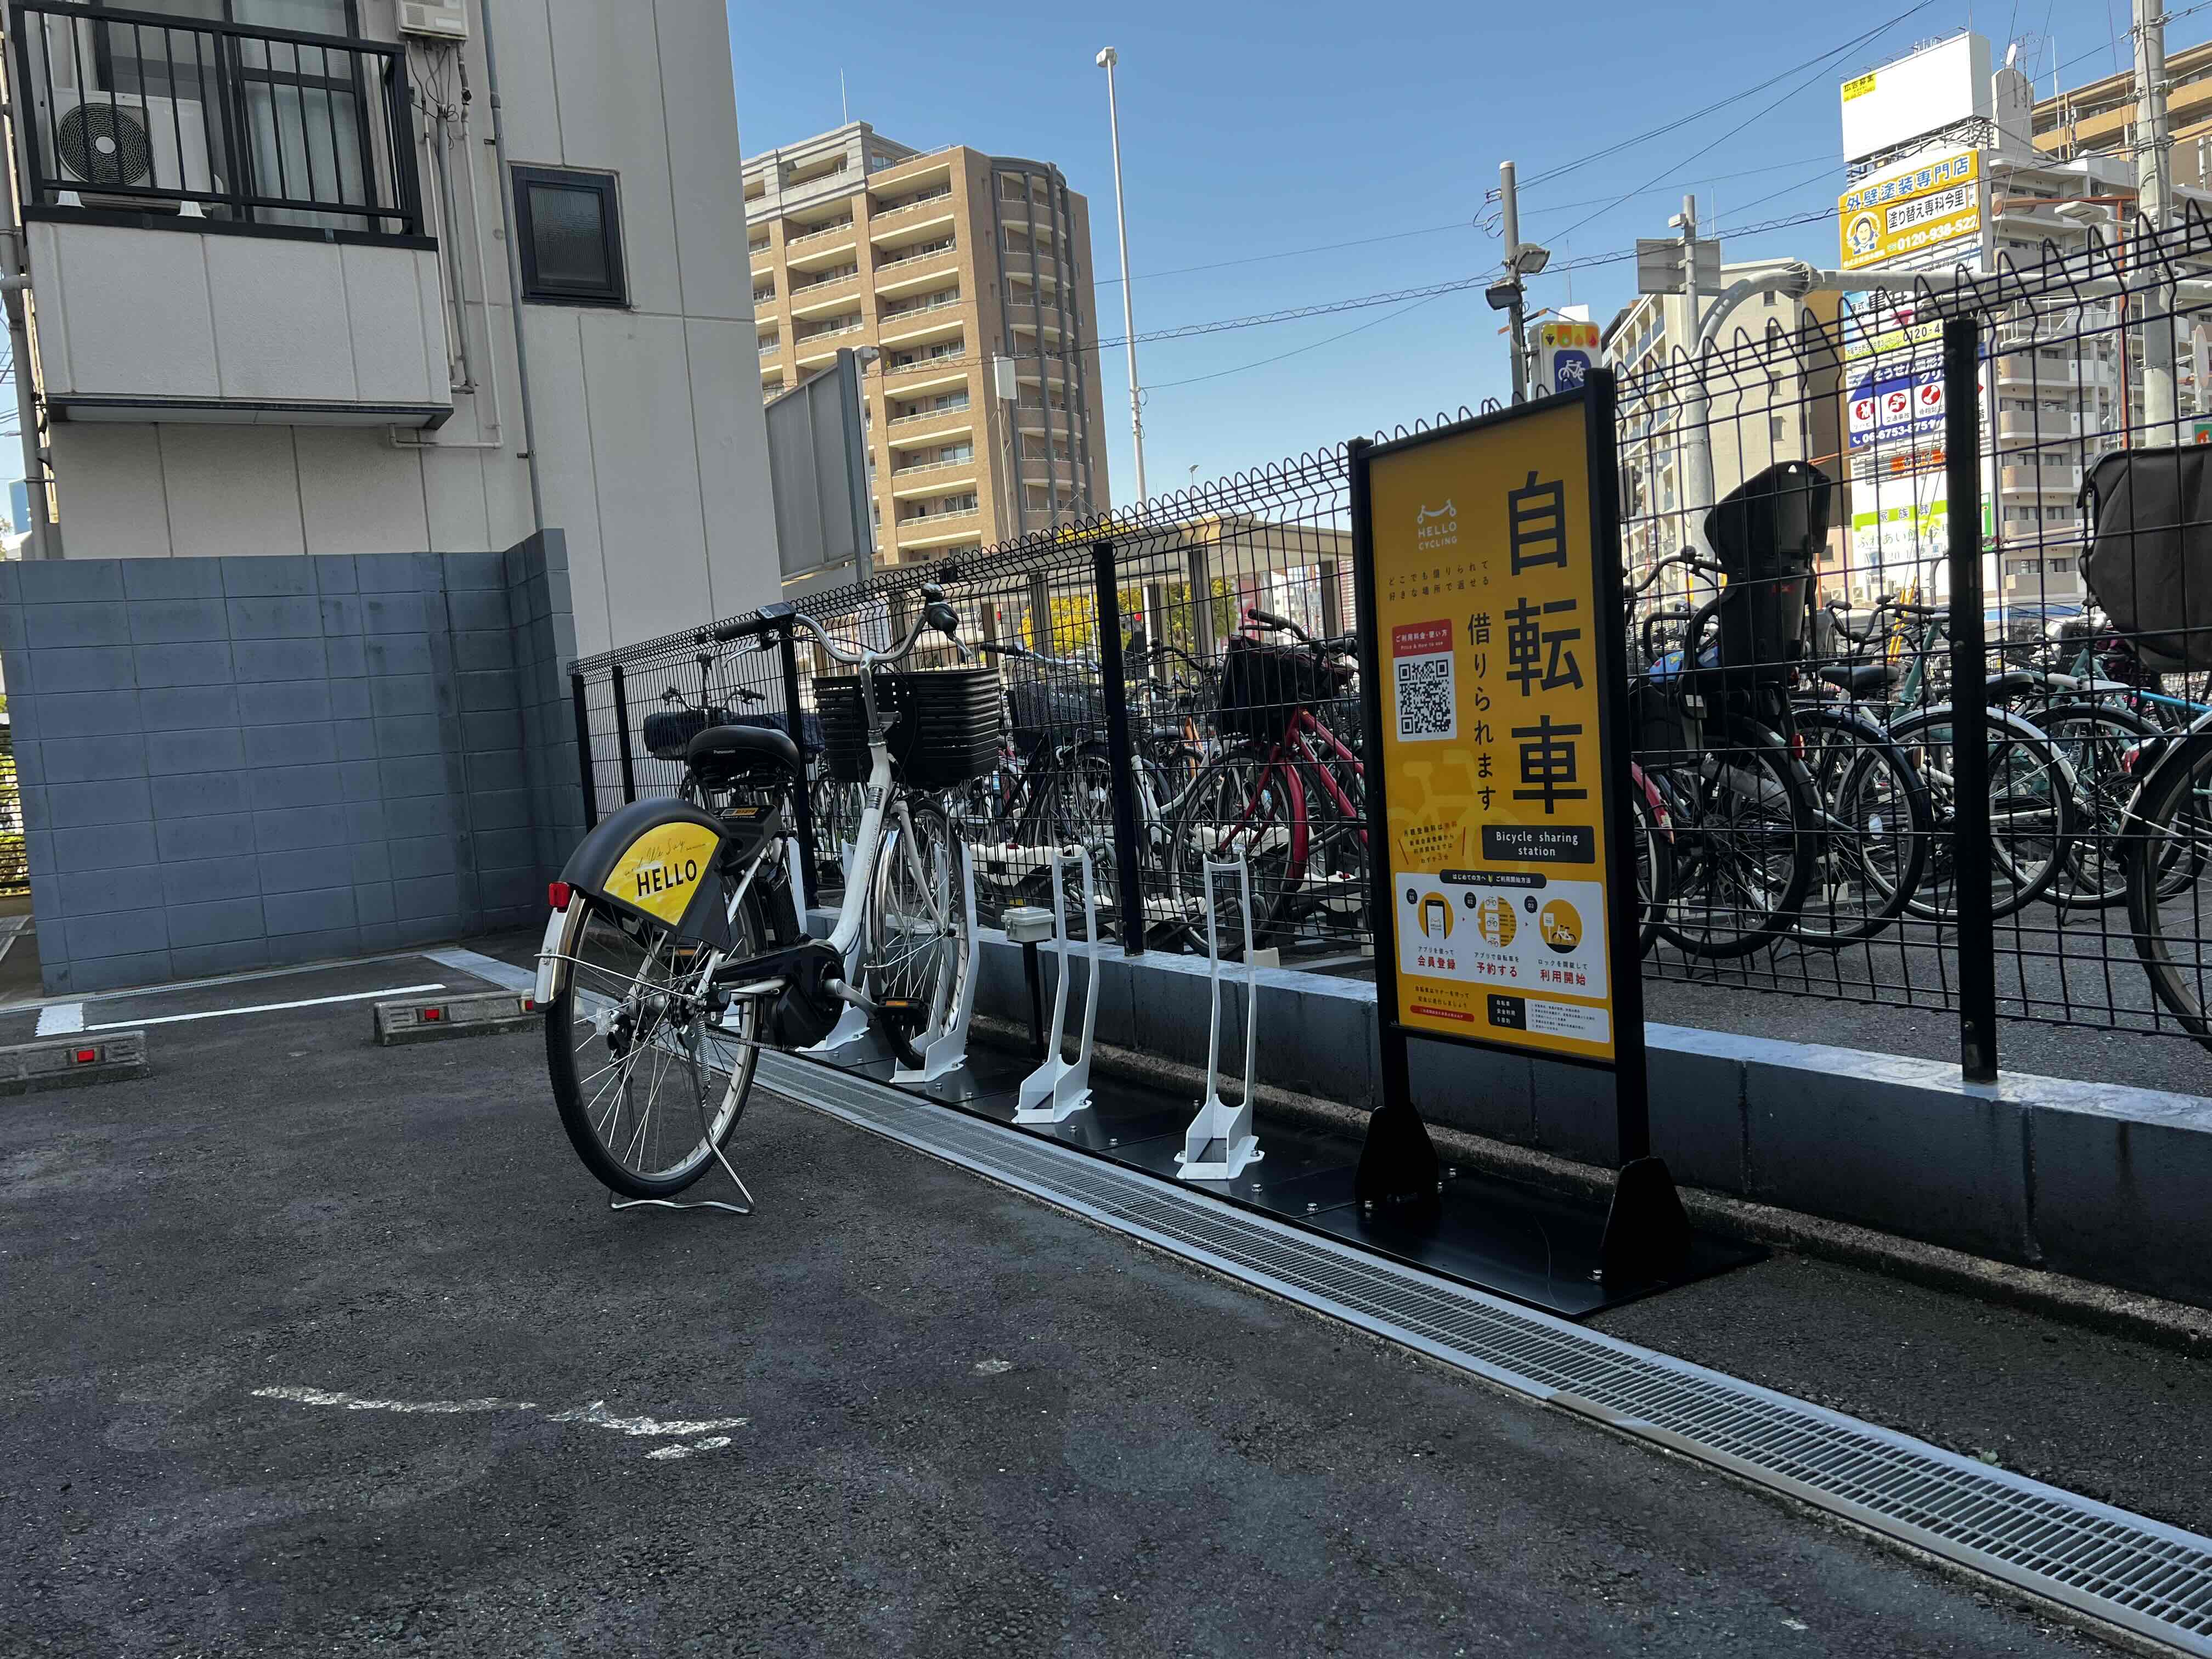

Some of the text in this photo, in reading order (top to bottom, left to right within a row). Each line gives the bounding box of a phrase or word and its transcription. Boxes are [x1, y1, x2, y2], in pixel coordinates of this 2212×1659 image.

[1847, 156, 1970, 212] 外壁塗装専門店
[1888, 188, 1965, 229] 塗り替え専科今里
[1418, 522, 1457, 538] HELLO
[1418, 535, 1458, 551] CYCLING
[1389, 559, 1488, 586] どこでも借りられて
[1389, 576, 1489, 601] 好きな場所で返せる
[1504, 470, 1588, 815] 自転車
[1468, 613, 1496, 811] 借りられます
[1496, 831, 1578, 845] Bicycle sharing
[1518, 846, 1556, 856] station
[636, 859, 697, 896] HELLO
[1452, 873, 1486, 882] はじめての方へ
[1417, 955, 1456, 970] 会員登録
[1476, 962, 1517, 978] 予約する
[1540, 969, 1586, 986] 利用開始
